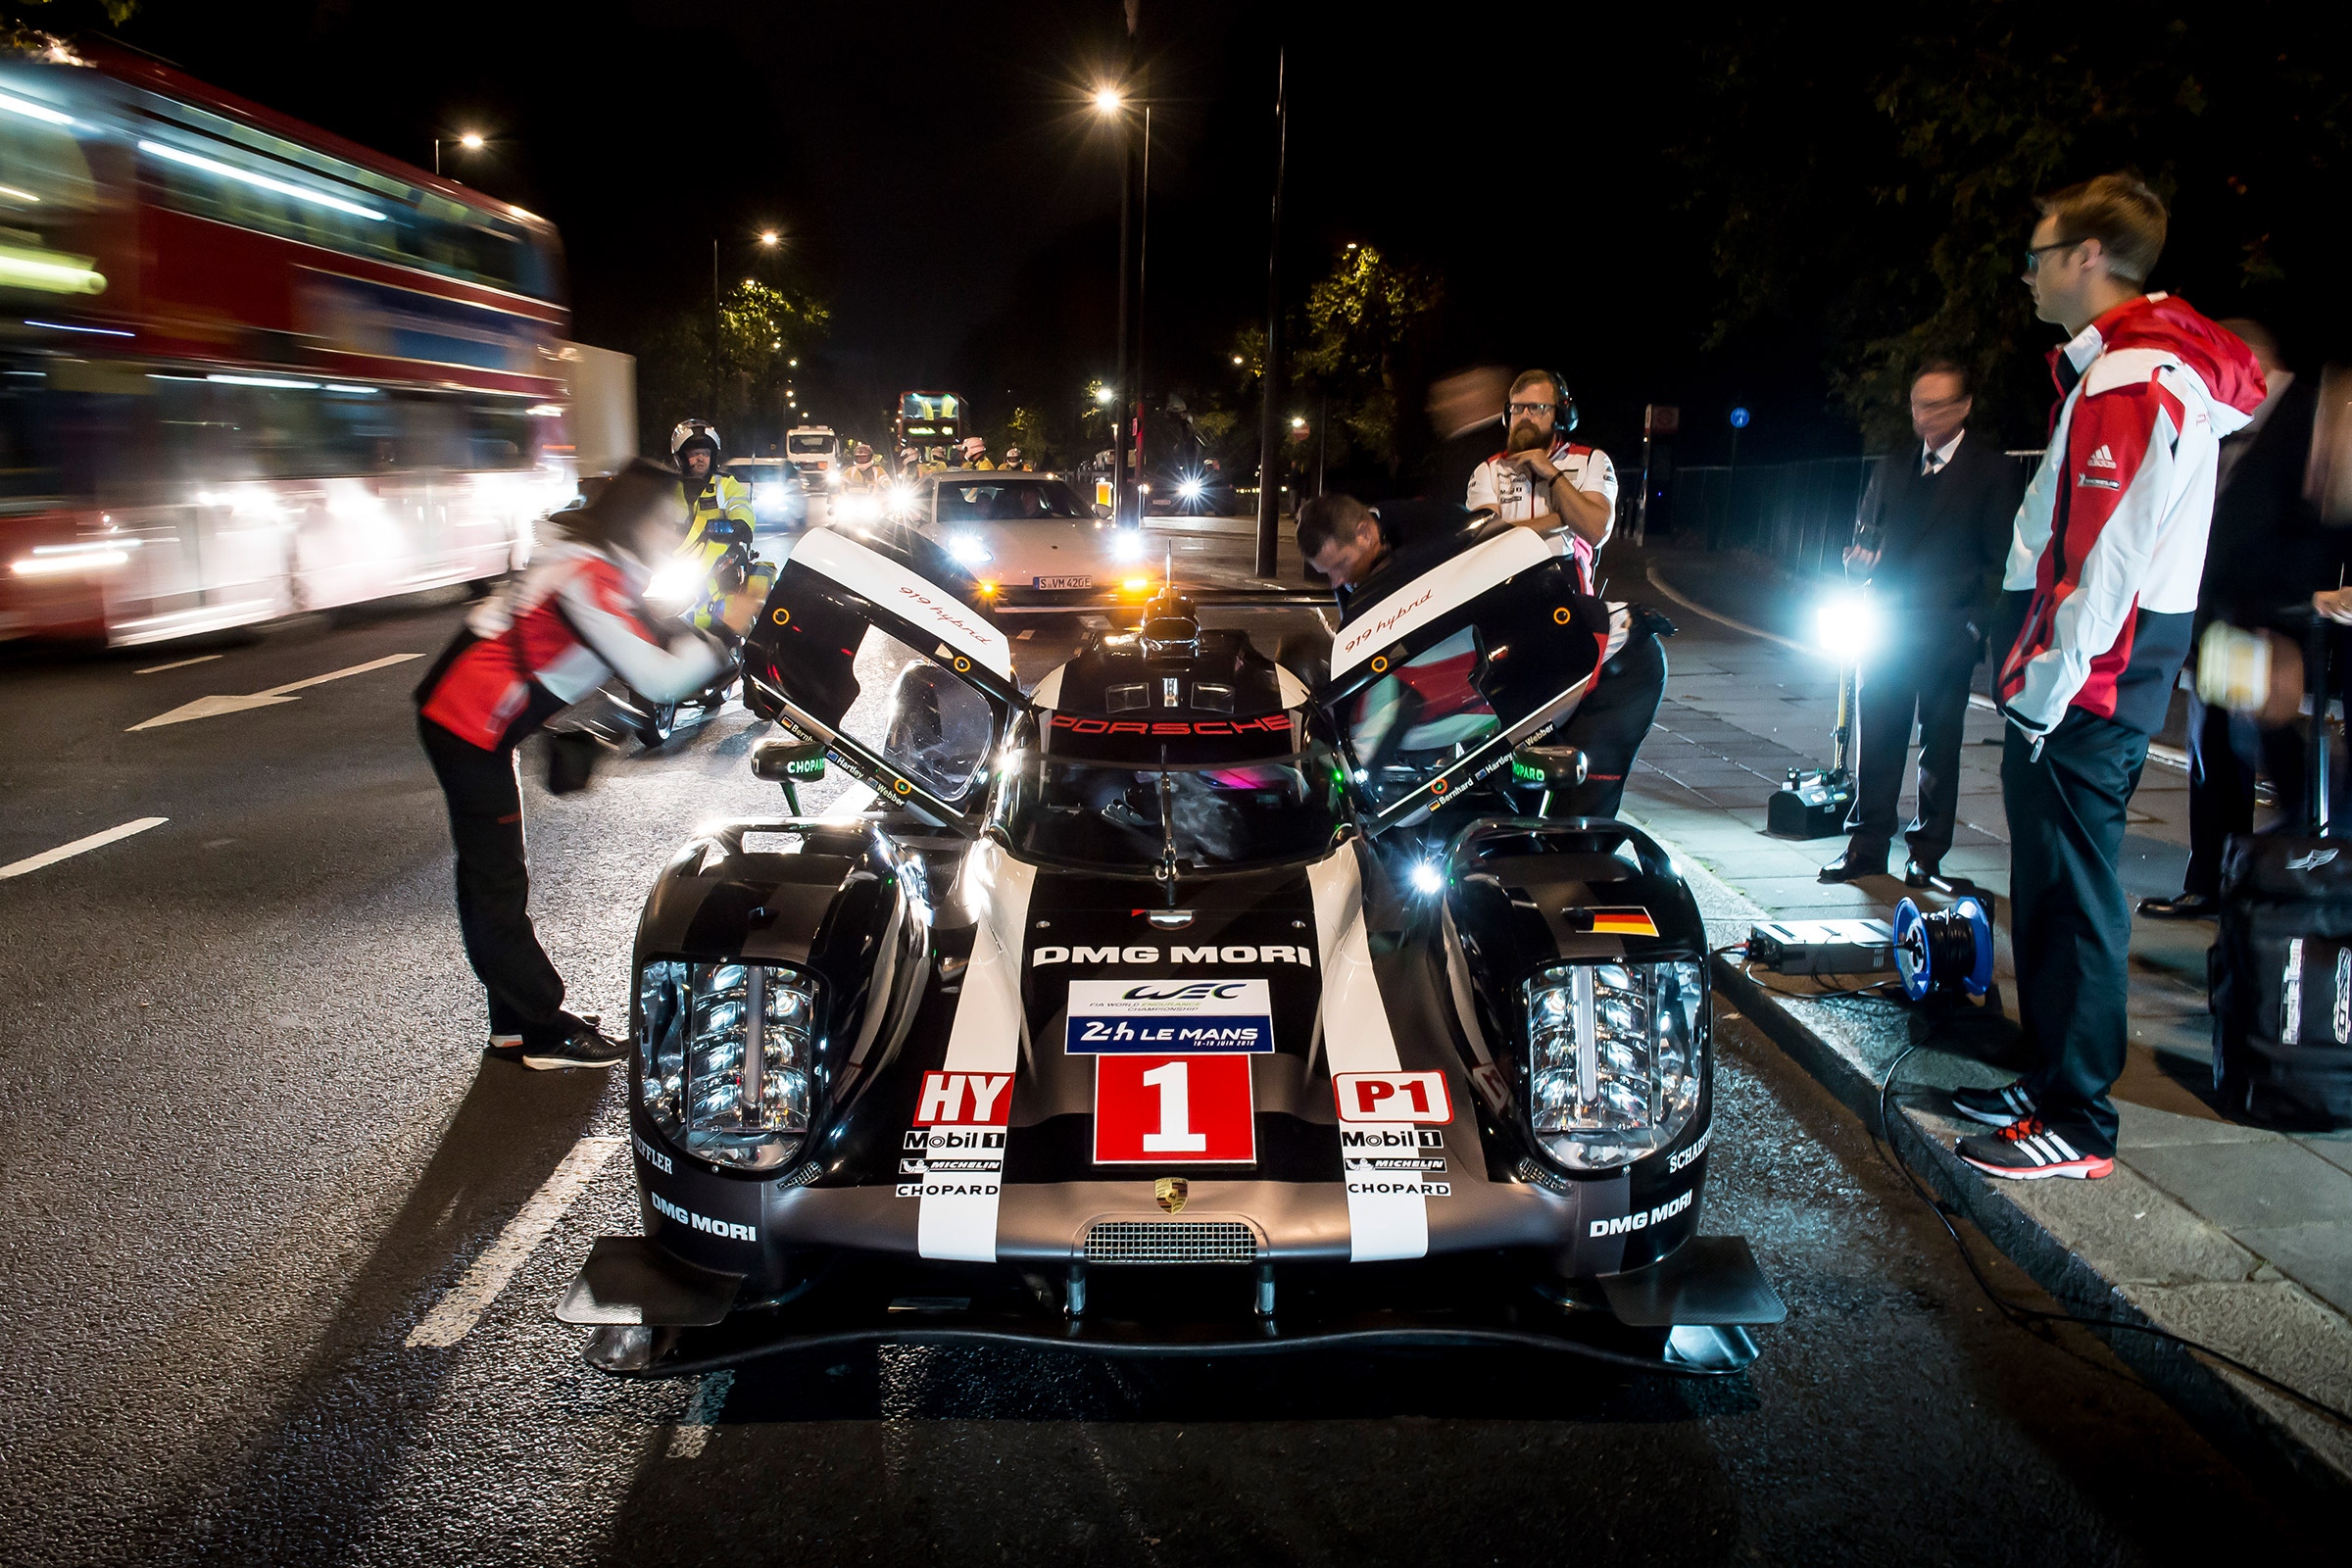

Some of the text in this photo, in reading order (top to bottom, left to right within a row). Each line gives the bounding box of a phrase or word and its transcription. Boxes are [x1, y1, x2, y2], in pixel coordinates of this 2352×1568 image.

[1040, 578, 1047, 589] S
[1052, 578, 1065, 588] VM
[898, 585, 993, 647] 919 hybrid
[1345, 588, 1433, 655] 919 hybrid
[1046, 713, 1295, 735] PORSCHE
[791, 722, 906, 808] Bernh Hartley Webber
[1439, 723, 1554, 806] Bernhard Hartley Webber
[1033, 946, 1312, 967] DMG MORI
[1122, 983, 1247, 1000] WEC
[1080, 1020, 1258, 1041] 24h LE MANS
[917, 1074, 1010, 1122] HY
[1143, 1060, 1206, 1152] 1
[1355, 1080, 1430, 1113] P1
[905, 1132, 978, 1149] Mobil
[1342, 1131, 1414, 1147] Mobil
[1375, 1159, 1444, 1168] MICHELIN
[898, 1185, 999, 1196] CHOPARD
[1348, 1183, 1449, 1195] CHOPARD
[651, 1191, 757, 1242] DMG MORI
[1590, 1188, 1693, 1238] DMG MORI
